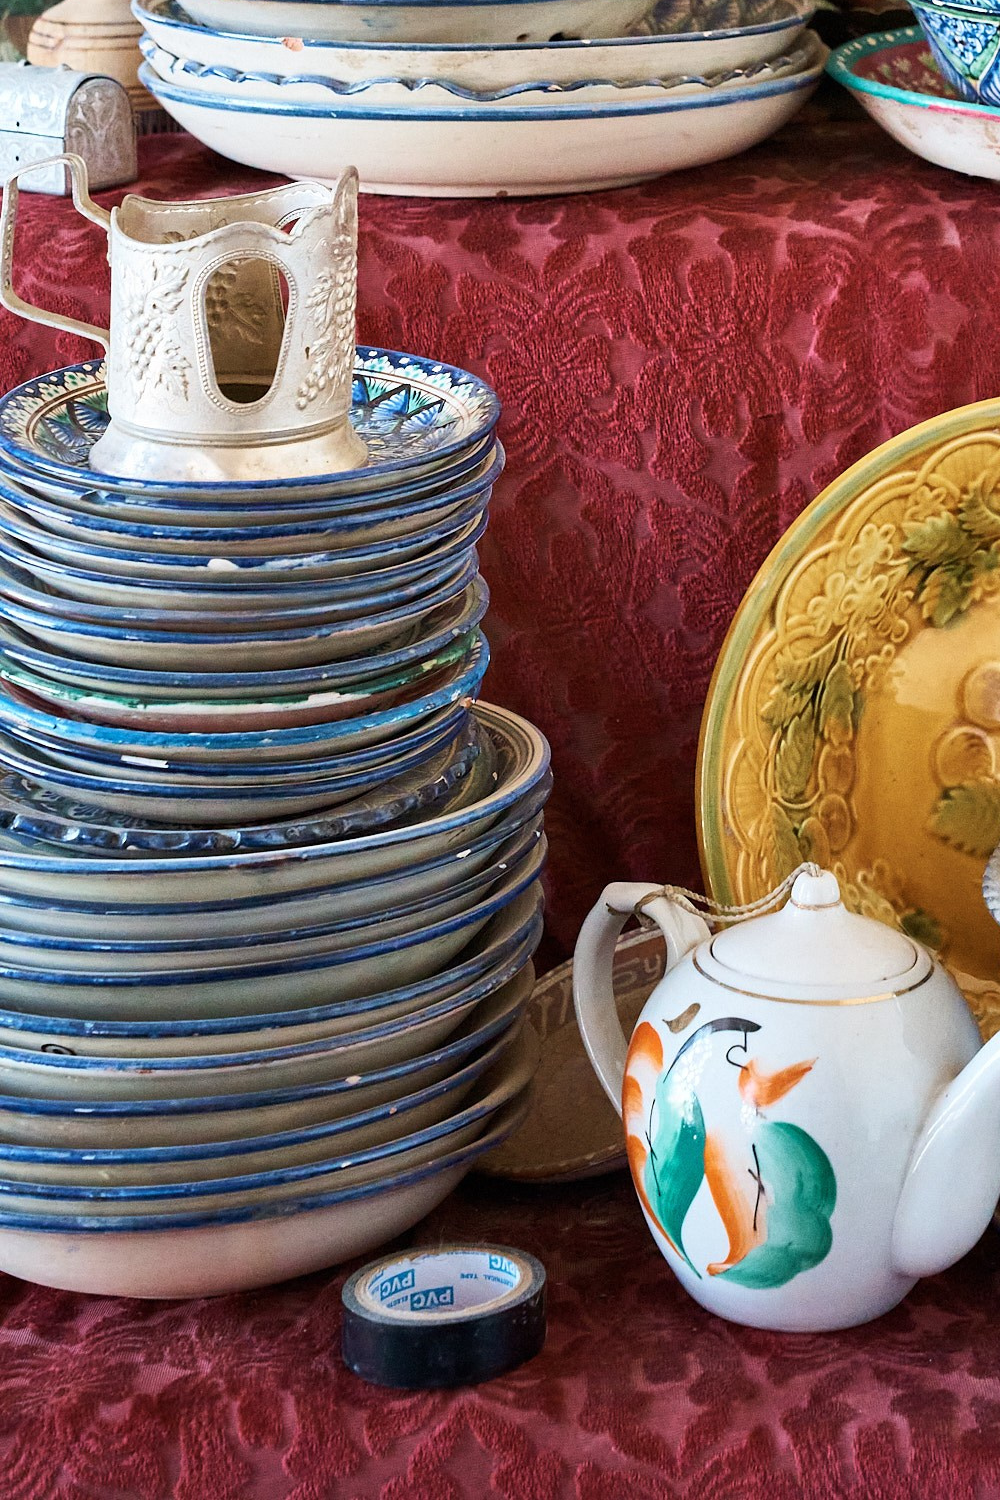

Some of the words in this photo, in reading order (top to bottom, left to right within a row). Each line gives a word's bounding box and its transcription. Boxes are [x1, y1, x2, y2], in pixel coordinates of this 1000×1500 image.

[381, 1271, 413, 1297] PVC
[460, 1272, 478, 1280] TAPE
[483, 1274, 514, 1288] ELECTRICAL
[412, 1289, 451, 1309] PVC
